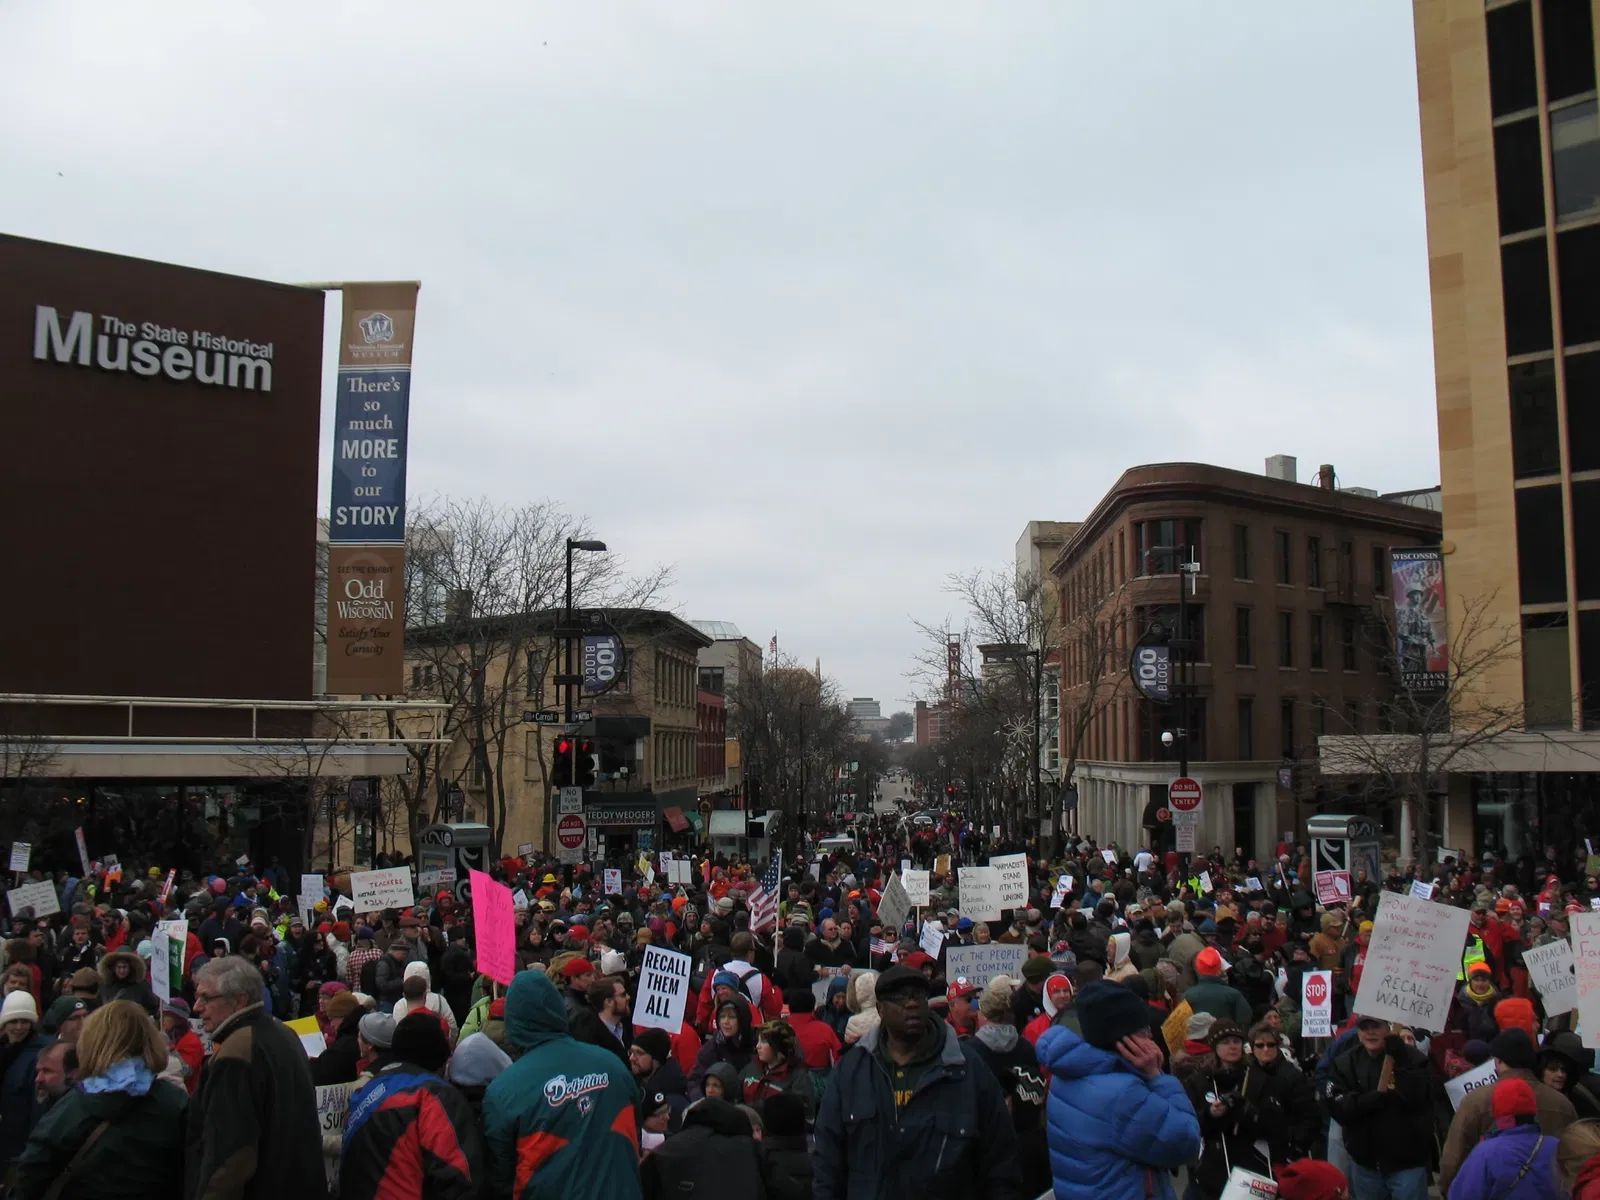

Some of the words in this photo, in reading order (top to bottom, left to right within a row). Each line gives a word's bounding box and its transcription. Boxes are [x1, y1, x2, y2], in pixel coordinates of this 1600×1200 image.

[100, 314, 137, 337] The
[140, 322, 188, 344] State
[192, 330, 273, 360] Historical
[33, 304, 272, 392] Museum
[346, 376, 400, 392] There's
[364, 400, 380, 411] so
[348, 414, 394, 430] much
[342, 438, 398, 459] MORE
[361, 466, 376, 477] to
[354, 486, 382, 496] our
[336, 506, 400, 526] STORY
[345, 579, 384, 600] Odd
[336, 601, 394, 620] WISCONSIN
[338, 626, 368, 641] Satisfy
[345, 642, 384, 656] Curiosity
[586, 646, 596, 682] BLOCK
[597, 638, 615, 680] 100
[1140, 648, 1157, 690] 100
[1158, 656, 1168, 692] BLOCK
[535, 712, 554, 720] Carroll
[1002, 872, 1021, 880] STAND
[1003, 892, 1023, 902] UNIONS
[645, 951, 687, 977] RECALL
[950, 954, 964, 962] WE
[971, 952, 984, 960] THE
[990, 949, 1021, 960] PEOPLE
[1528, 944, 1566, 965] IMPEACH
[955, 965, 970, 974] ARE
[976, 963, 1014, 972] COMING
[1543, 960, 1562, 977] THE
[647, 972, 679, 995] THEM
[1307, 984, 1326, 997] STOP
[1381, 975, 1428, 999] RECALL
[1539, 977, 1576, 995] DICTATO
[646, 994, 670, 1018] ALL
[1376, 990, 1433, 1018] WALKER
[544, 1072, 609, 1107] Dolphins
[1464, 1069, 1499, 1094] Recal
[323, 1112, 345, 1130] SUP
